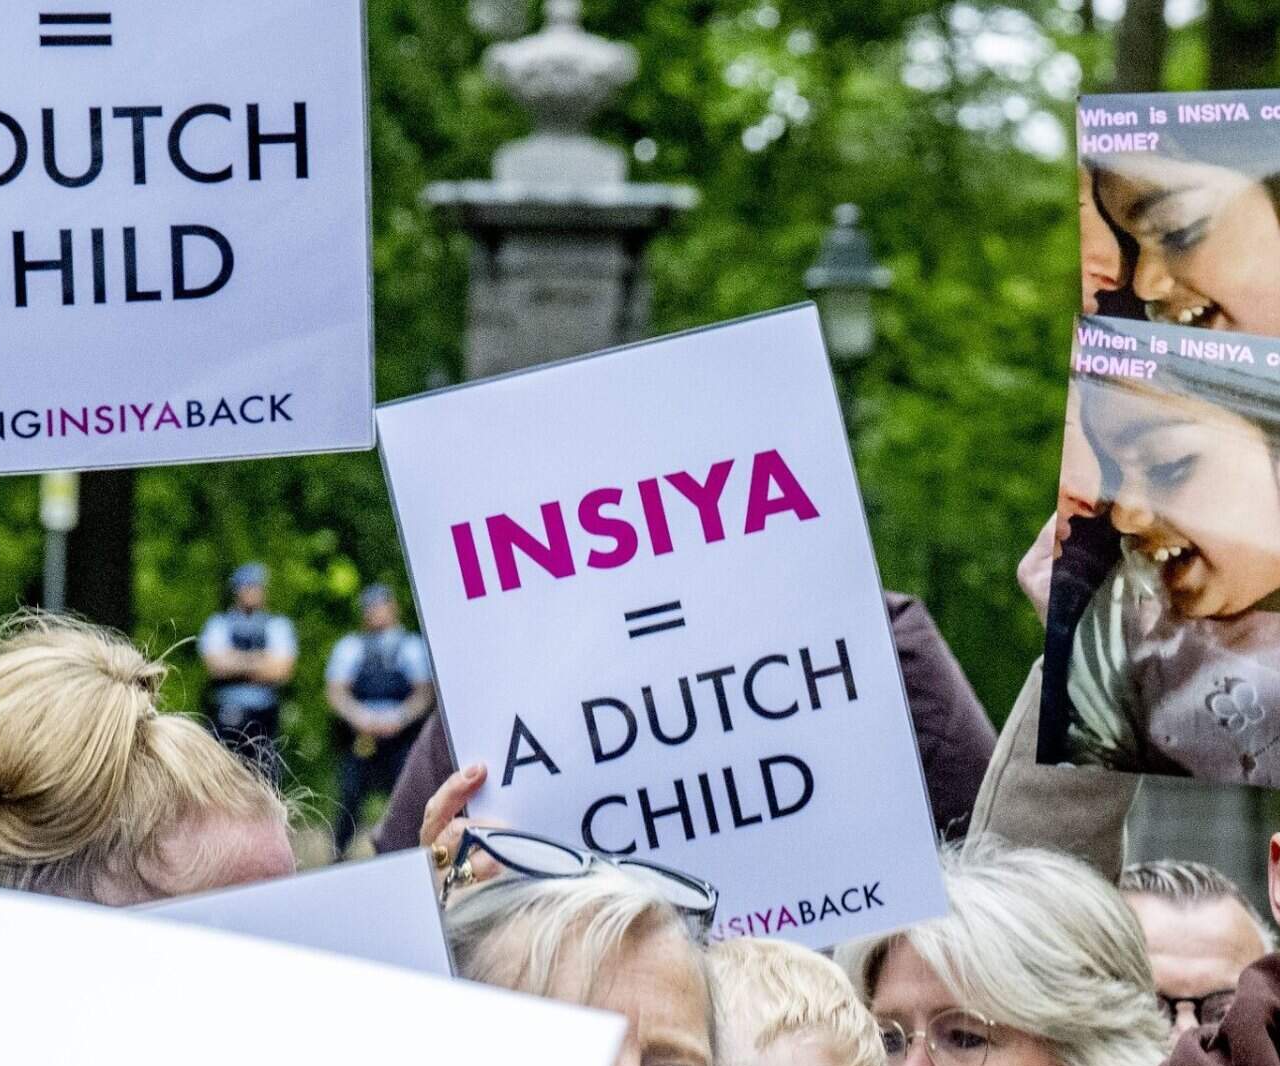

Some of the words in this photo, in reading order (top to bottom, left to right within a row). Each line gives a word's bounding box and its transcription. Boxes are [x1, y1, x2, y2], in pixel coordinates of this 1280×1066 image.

[1081, 108, 1138, 127] When
[1149, 106, 1168, 125] is
[1178, 102, 1249, 123] INSIYA
[1081, 132, 1159, 154] HOME?
[1077, 327, 1137, 352] When
[1150, 335, 1169, 355] is
[1180, 338, 1255, 364] INSIYA
[1076, 355, 1157, 379] HOME?
[451, 448, 821, 600] INSIYA
[501, 714, 561, 787] A
[581, 639, 859, 765] DUTCH
[581, 753, 815, 856] CHILD
